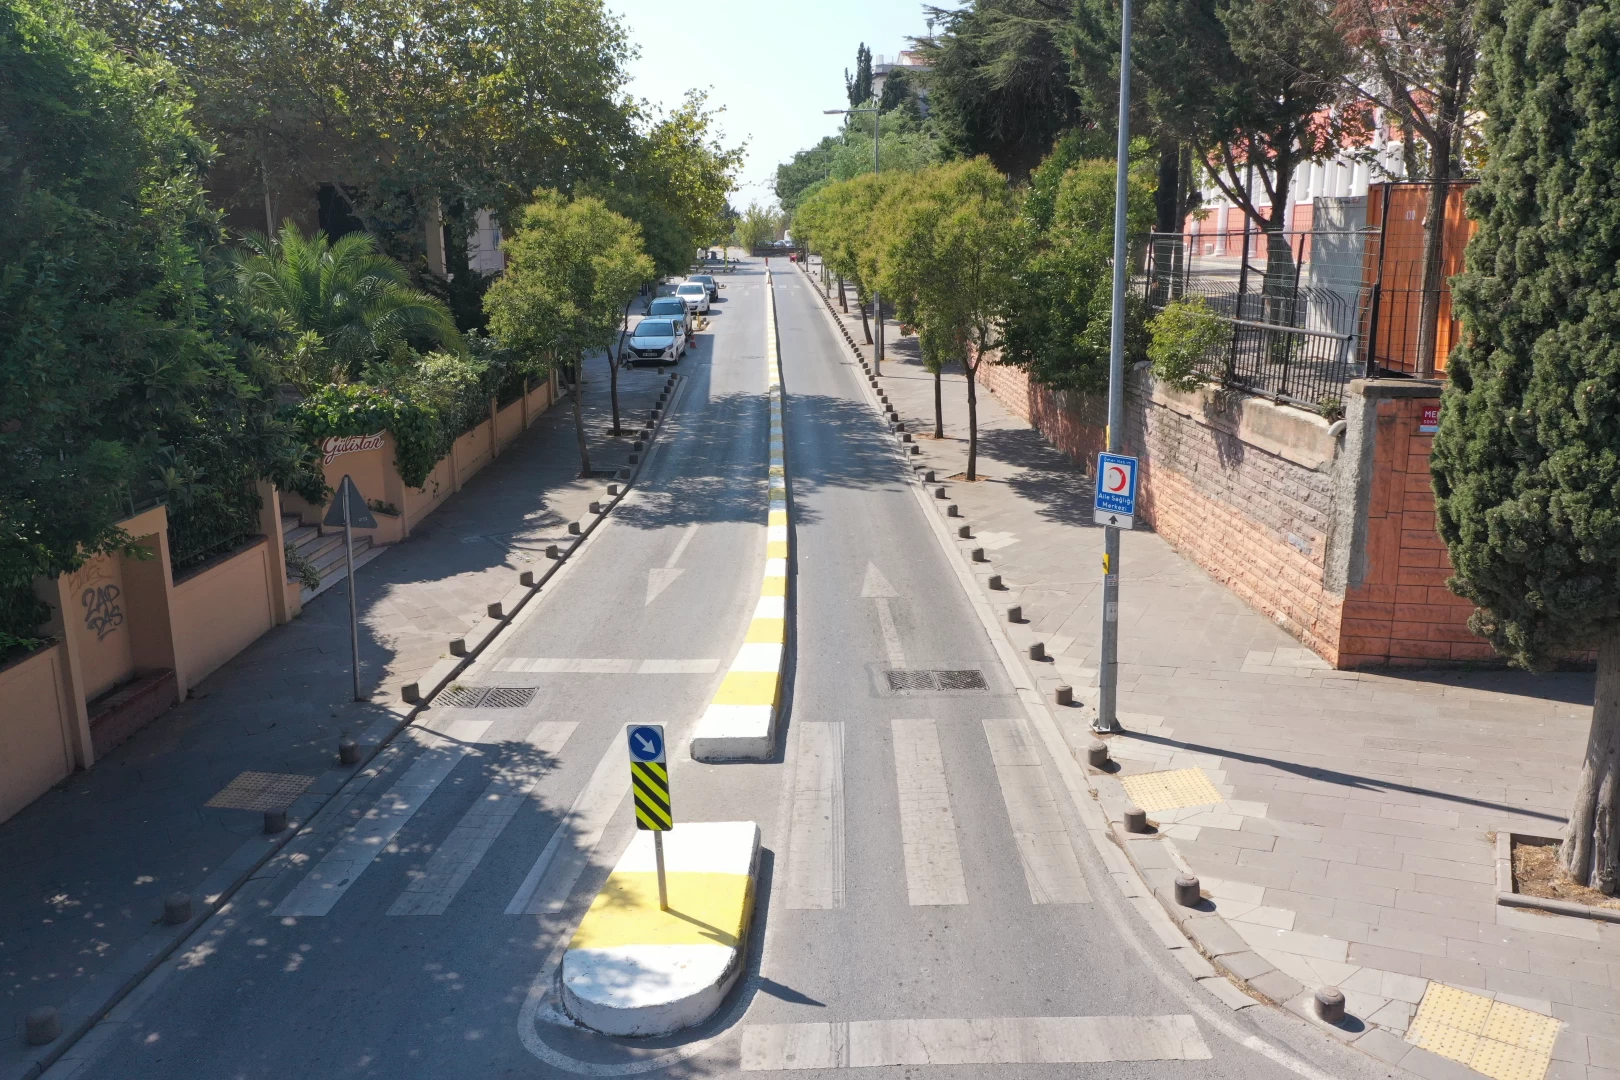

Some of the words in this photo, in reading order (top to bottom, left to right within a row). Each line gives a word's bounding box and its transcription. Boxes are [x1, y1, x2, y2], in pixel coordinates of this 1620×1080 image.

[322, 428, 387, 466] Gülistan
[1098, 492, 1110, 501] Aile
[1111, 495, 1133, 506] Sağlığı
[1102, 501, 1127, 512] Merkezi
